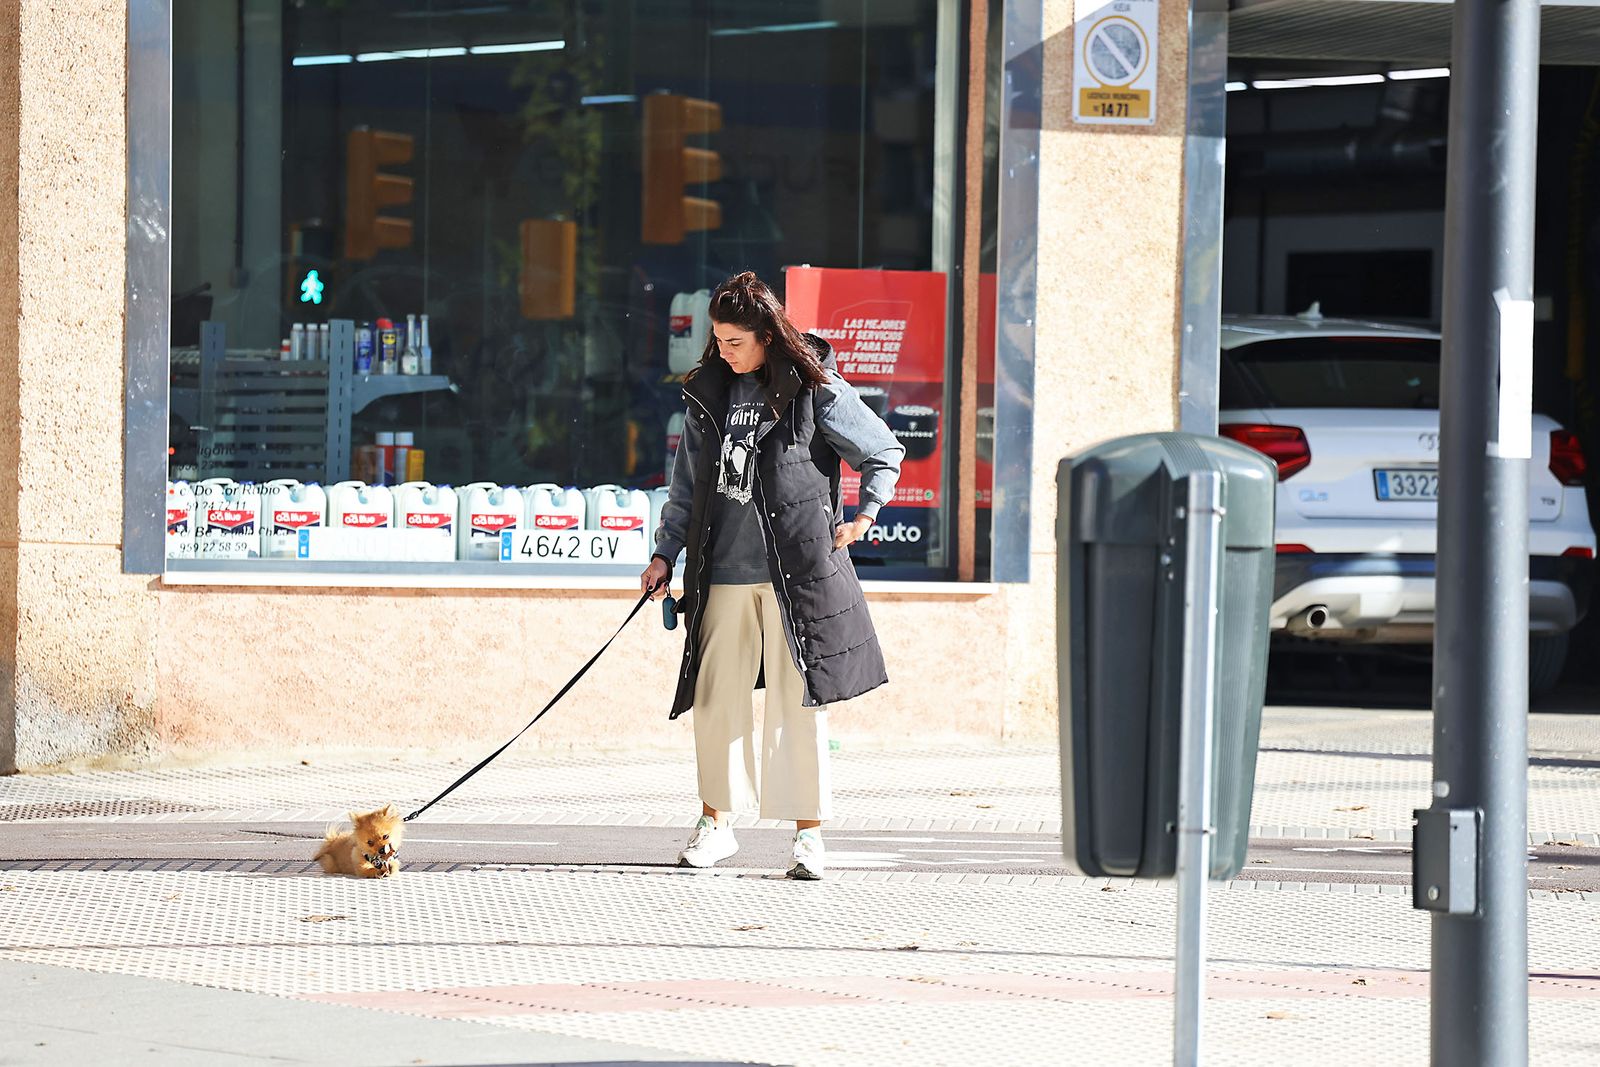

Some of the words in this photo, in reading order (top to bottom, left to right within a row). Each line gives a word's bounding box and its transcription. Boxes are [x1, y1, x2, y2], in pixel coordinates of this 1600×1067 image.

[843, 318, 864, 329] LAS
[864, 319, 907, 330] MEJORES
[848, 330, 857, 340] Y
[856, 330, 904, 341] SERVICIOS
[854, 341, 881, 351] PARA
[882, 341, 902, 352] SER
[851, 352, 898, 363] PRIMEROS
[842, 363, 857, 373] DE
[857, 363, 895, 374] HUELVA
[730, 409, 760, 426] Girls
[521, 535, 580, 558] 4642
[590, 536, 619, 558] GV
